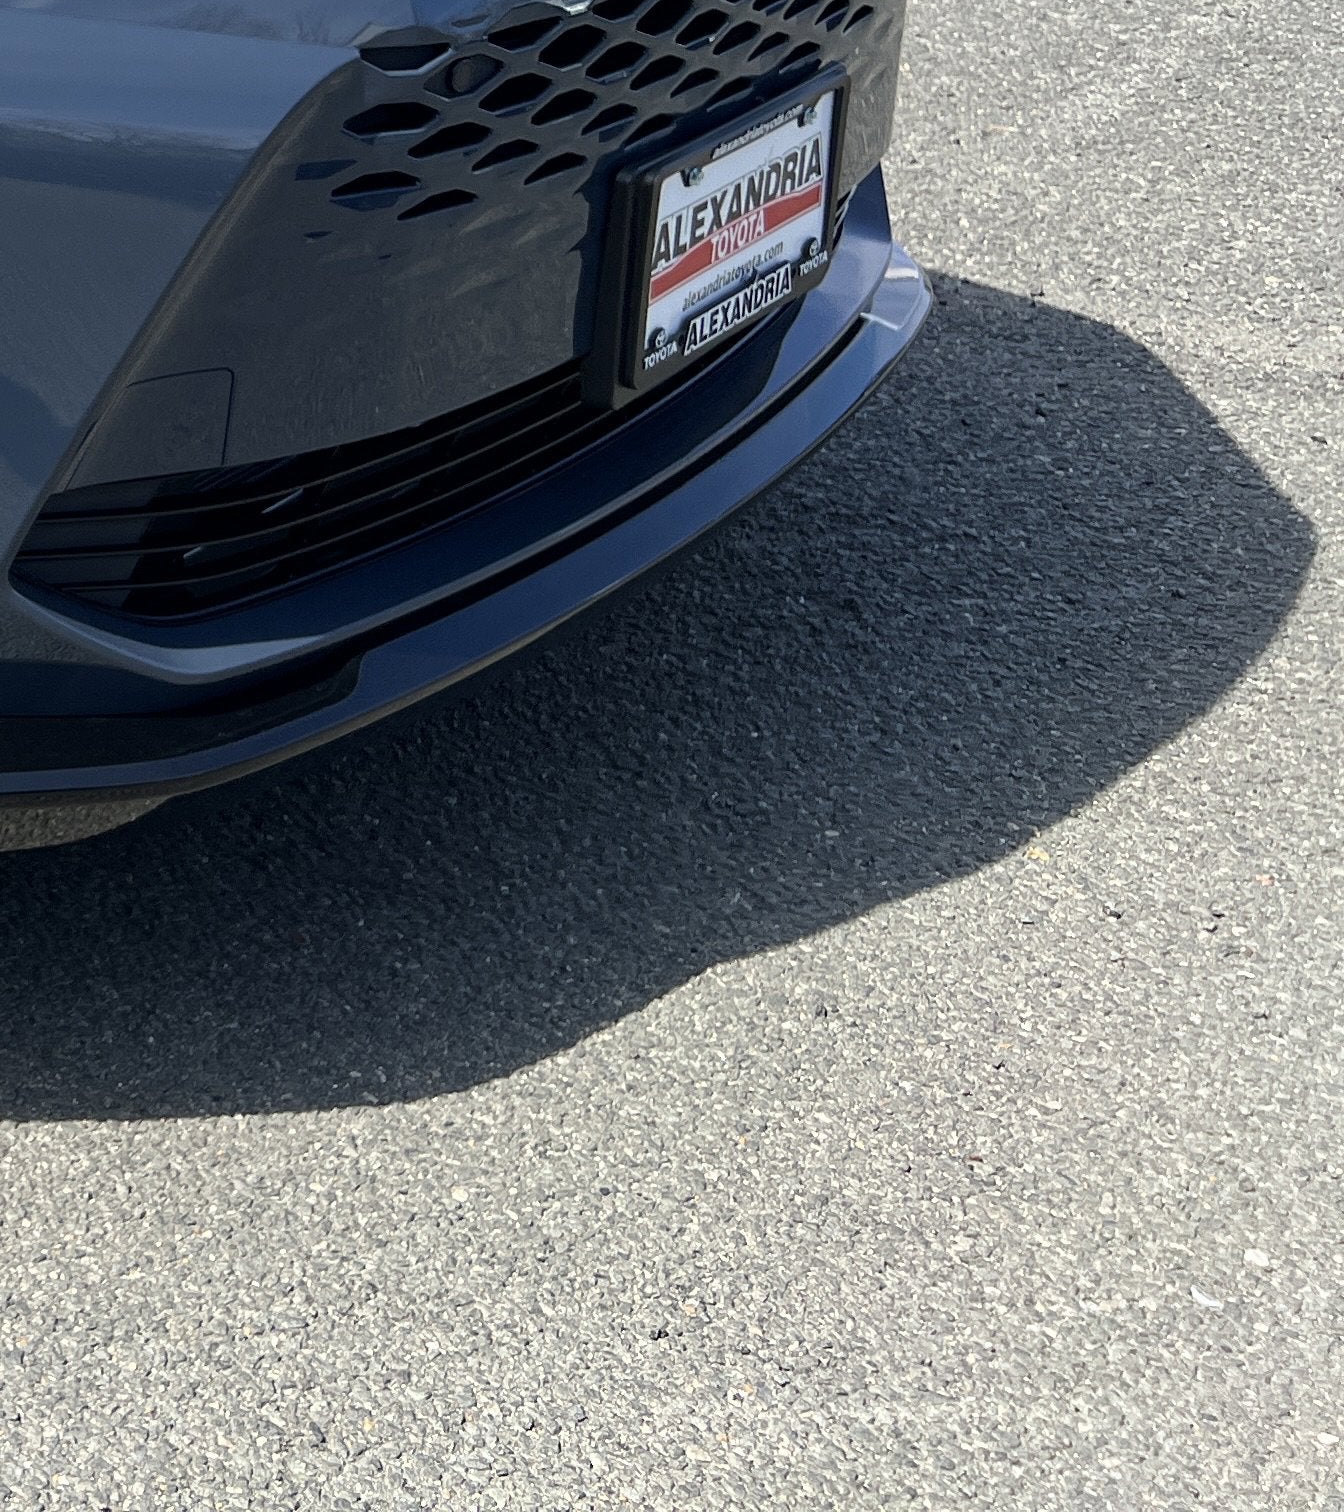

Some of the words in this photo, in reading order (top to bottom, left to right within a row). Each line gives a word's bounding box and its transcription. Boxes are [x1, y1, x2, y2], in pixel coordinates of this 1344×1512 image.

[651, 136, 823, 270] ALEXANDRIA
[710, 213, 766, 265] TOYOTA
[799, 250, 829, 277] TOYOTA
[682, 240, 784, 312] alexandriatoyota.com
[685, 264, 792, 356] ALEXANDRIA
[643, 340, 678, 370] TOYOTA
